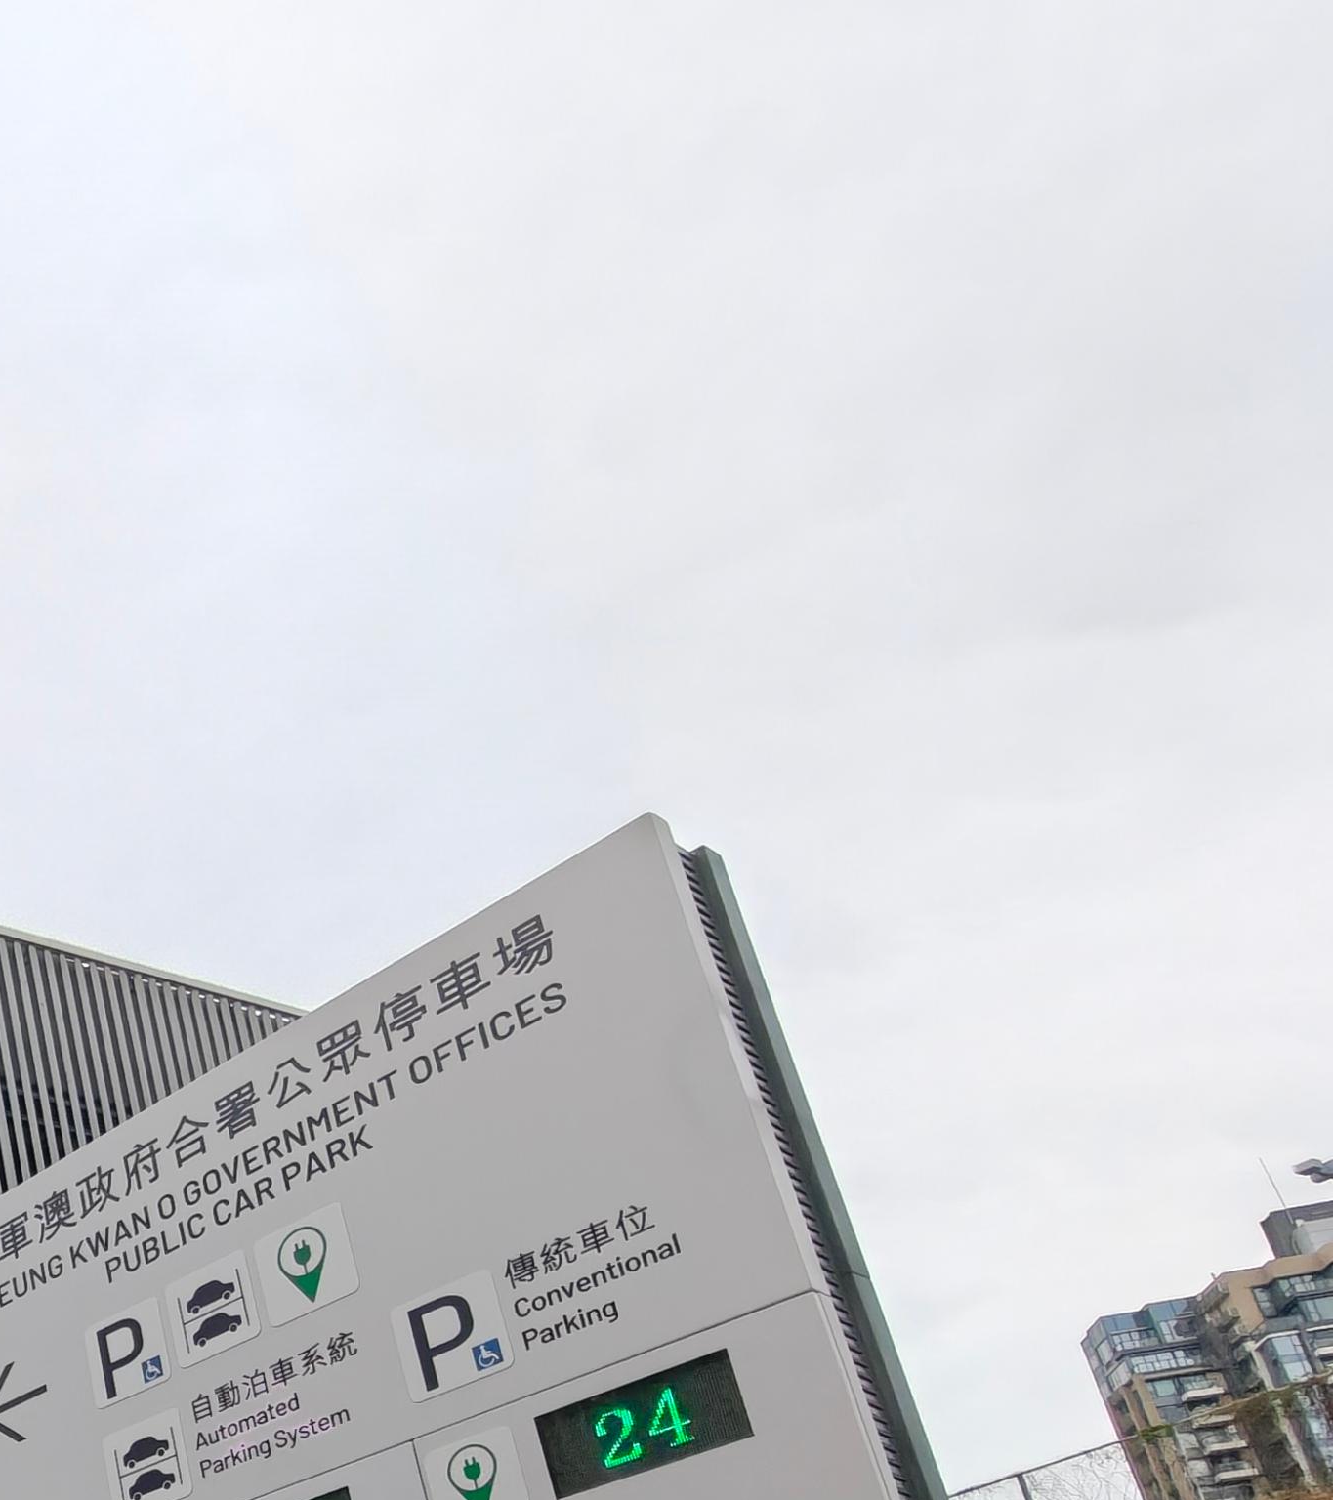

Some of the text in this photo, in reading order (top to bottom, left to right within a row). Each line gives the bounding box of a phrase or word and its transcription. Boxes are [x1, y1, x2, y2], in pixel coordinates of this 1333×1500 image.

[70, 1206, 150, 1271] KWAN
[159, 1193, 178, 1222] O
[184, 1070, 398, 1208] GOVERNMENT
[409, 983, 567, 1085] OFFICES
[105, 1124, 373, 1284] PUBLIC CAR PARK
[504, 1204, 656, 1289] 傳統車位
[514, 1233, 681, 1317] Conventional
[96, 1317, 144, 1399] P
[407, 1294, 474, 1392] P
[522, 1300, 619, 1351] Parking
[191, 1330, 358, 1424] 自動泊車系統
[194, 1393, 300, 1451] Automated
[199, 1407, 351, 1479] Parking System
[594, 1386, 694, 1469] 24
